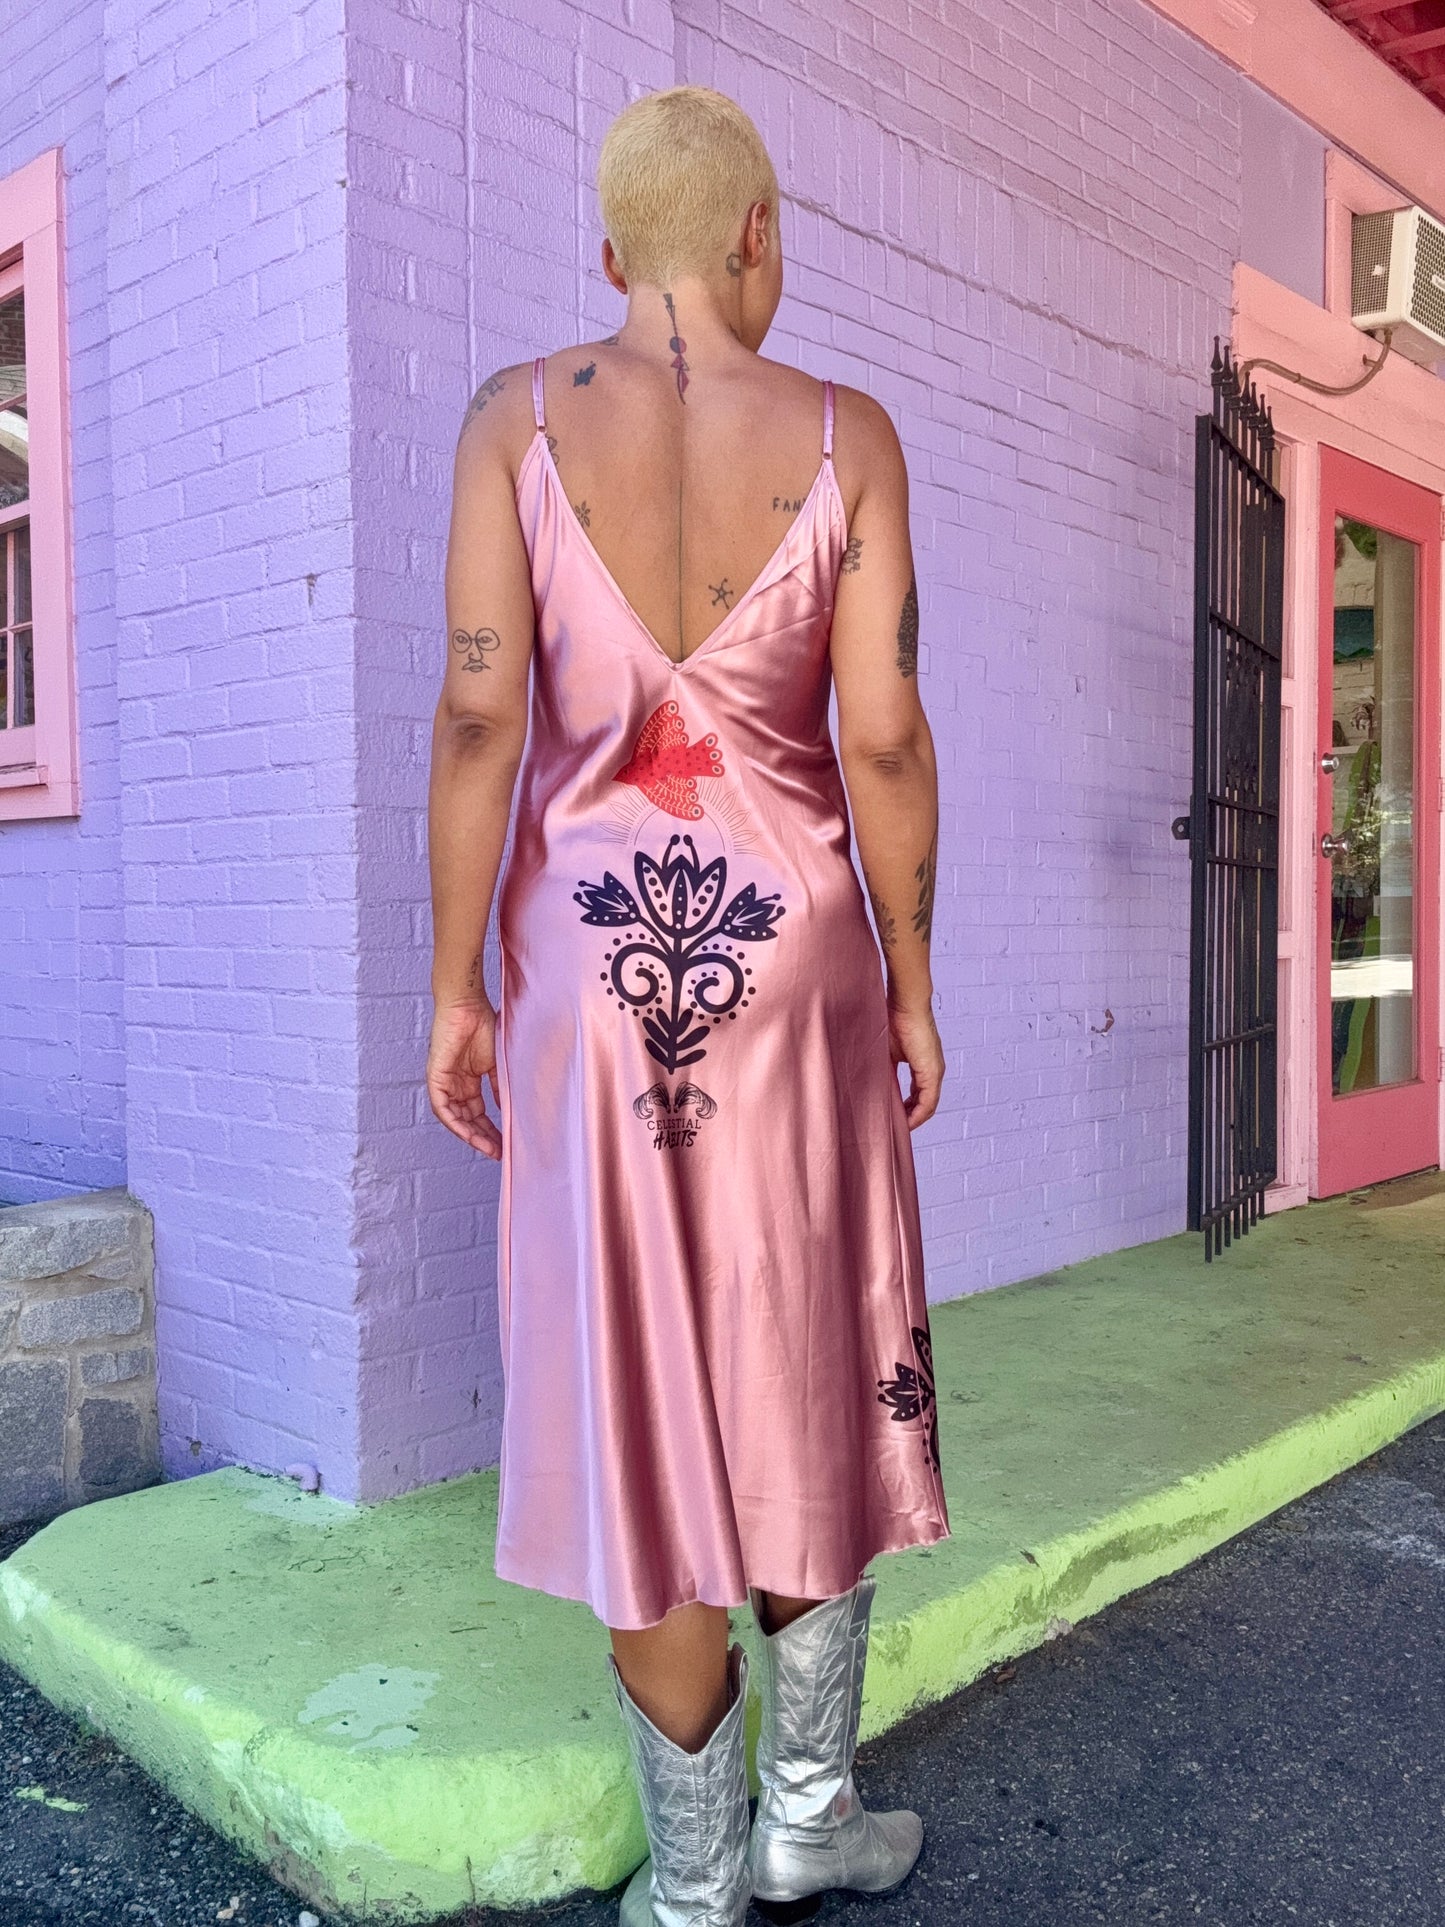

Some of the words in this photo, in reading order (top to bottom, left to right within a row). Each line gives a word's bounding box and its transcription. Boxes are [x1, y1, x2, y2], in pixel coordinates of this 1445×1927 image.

[772, 496, 807, 512] FAN
[646, 1118, 702, 1130] CELESTIAL
[653, 1129, 698, 1151] HABITS
